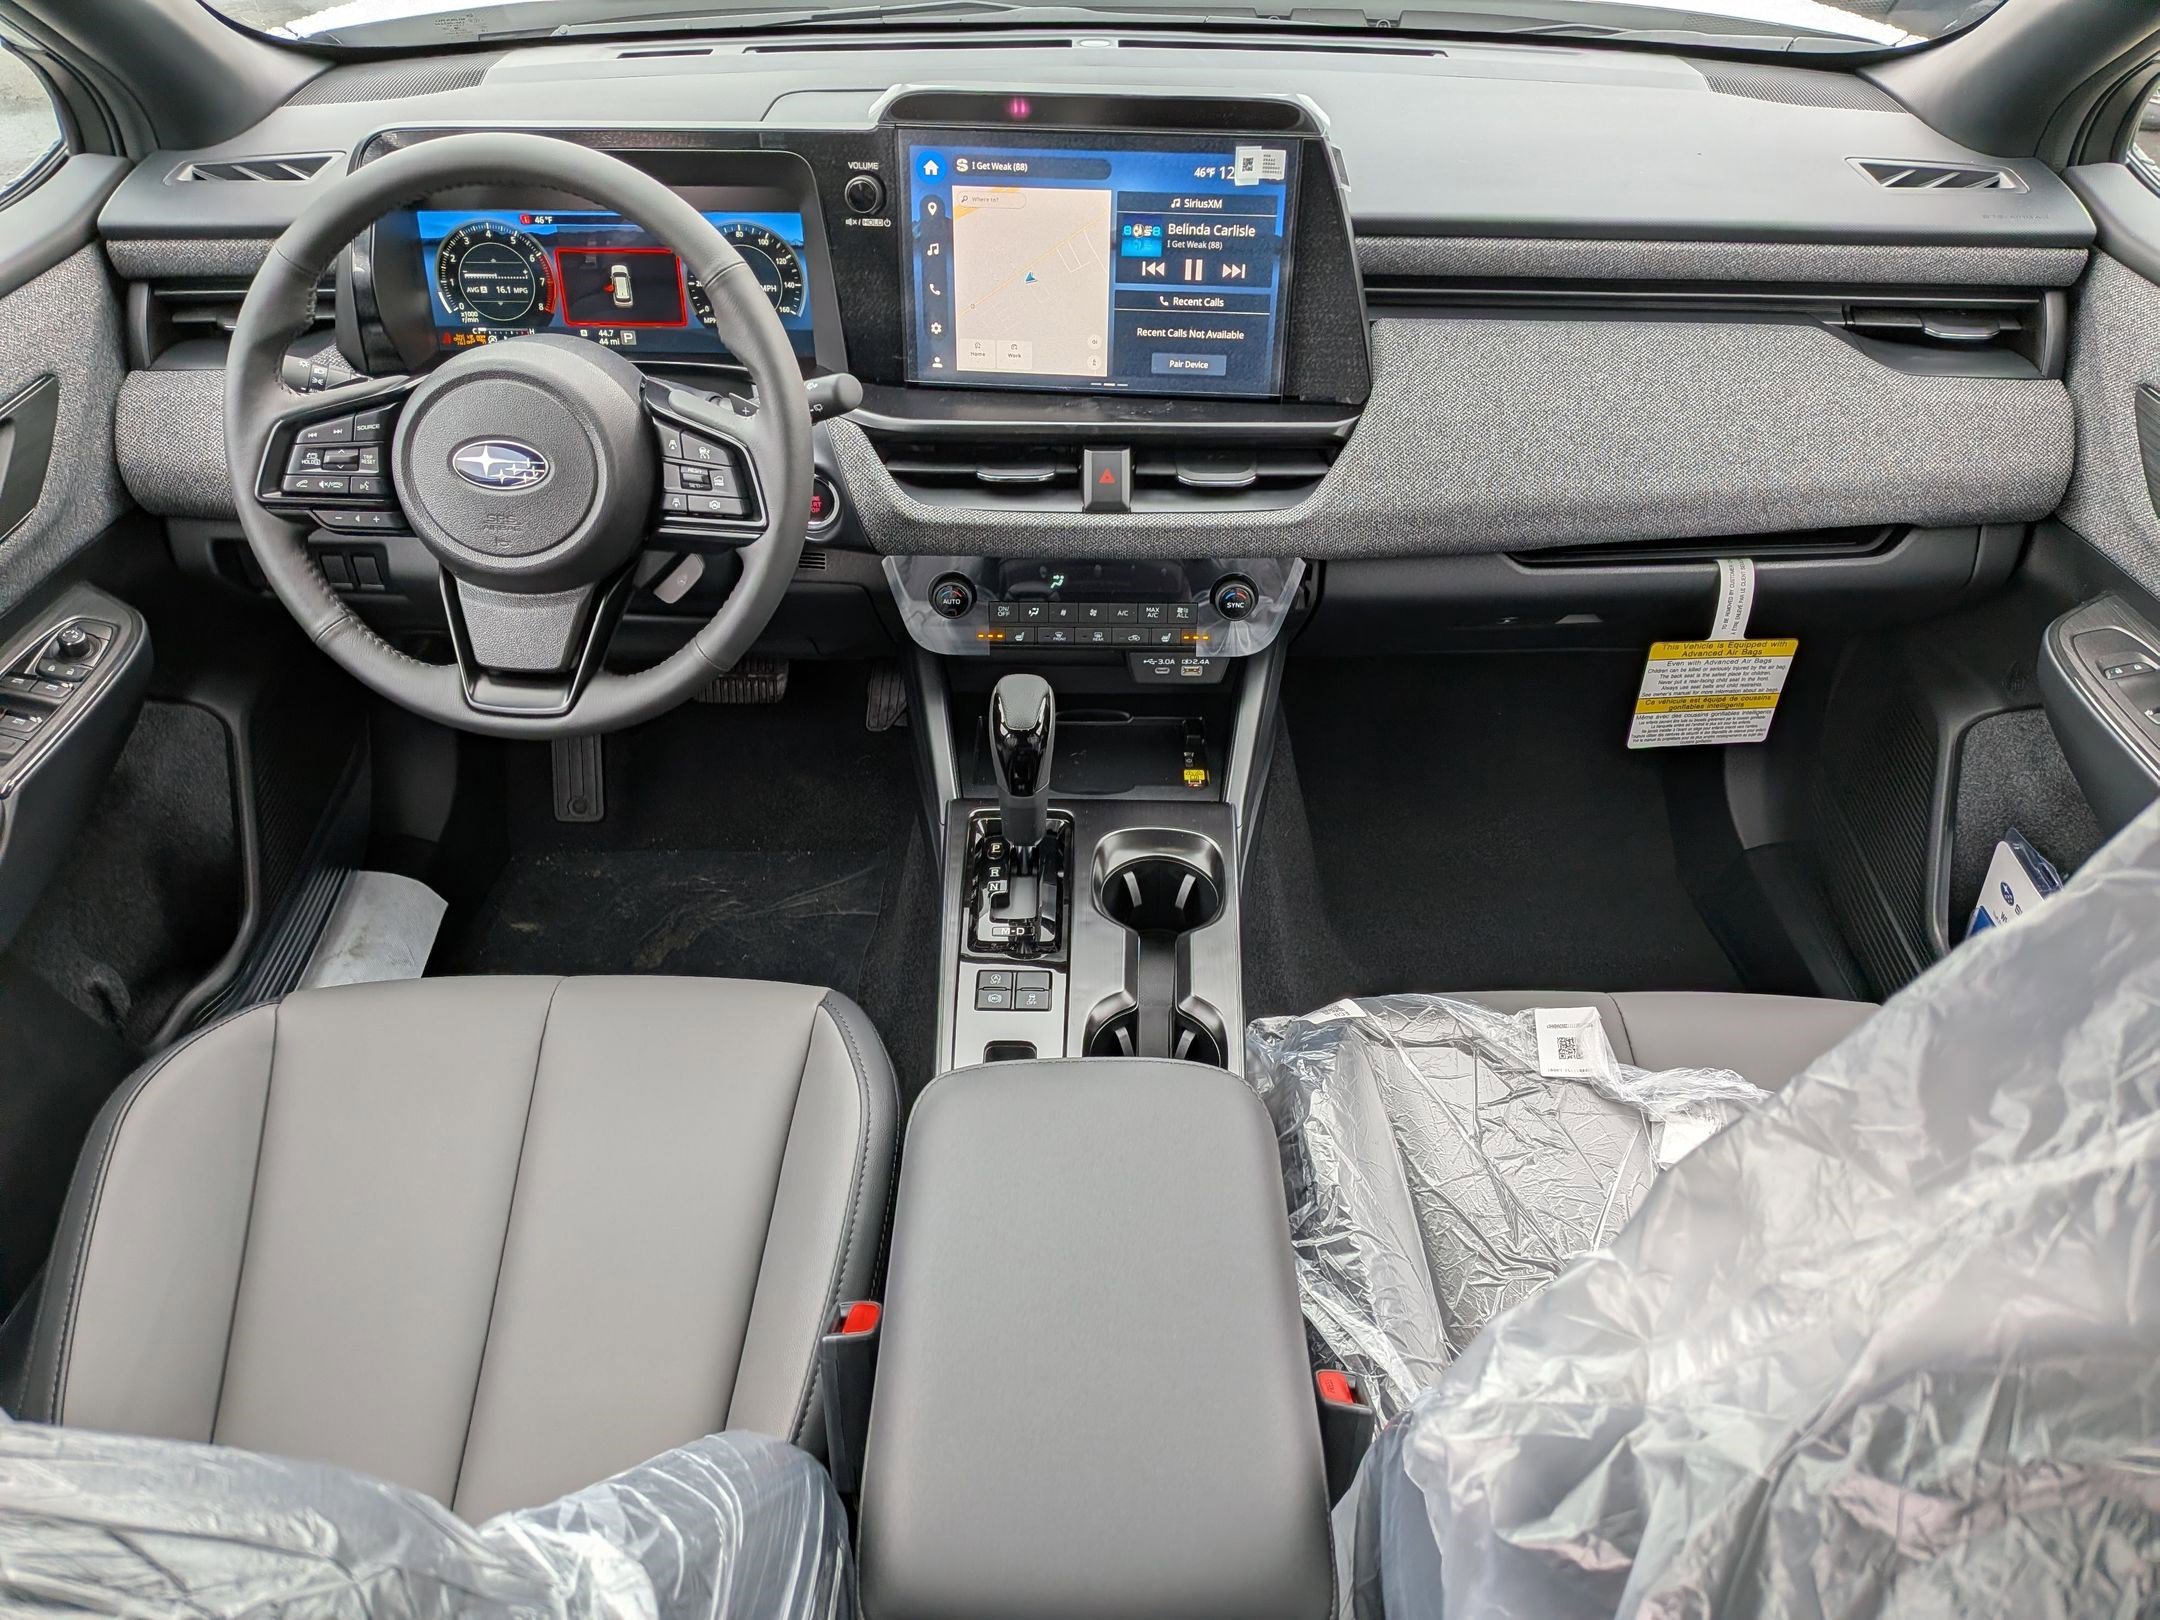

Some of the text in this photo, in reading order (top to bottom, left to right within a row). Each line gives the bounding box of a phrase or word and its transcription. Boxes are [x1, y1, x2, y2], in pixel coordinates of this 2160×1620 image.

[848, 162, 879, 170] VOLUME
[977, 162, 990, 170] Get
[991, 162, 1013, 171] Weak
[1012, 162, 1028, 172] (88)
[1184, 198, 1223, 209] SiriusXM
[1168, 223, 1211, 236] Belinda
[1213, 224, 1256, 238] Carlisle
[464, 237, 470, 245] 3
[1172, 240, 1185, 248] Get
[1186, 240, 1207, 249] Weak
[1208, 241, 1223, 250] (88)
[450, 254, 456, 262] 2
[540, 278, 546, 286] 7
[1172, 297, 1224, 307] Recent Calls
[598, 329, 614, 337] 44.7
[623, 332, 634, 343] P
[1136, 328, 1245, 340] Recent Calls Not Available
[1169, 360, 1208, 369] Pair Device
[1725, 597, 1734, 617] REMOVED
[1684, 642, 1714, 650] Vehicle
[1728, 641, 1768, 650] Equipped
[1742, 648, 1763, 656] Bags
[989, 883, 999, 891] N
